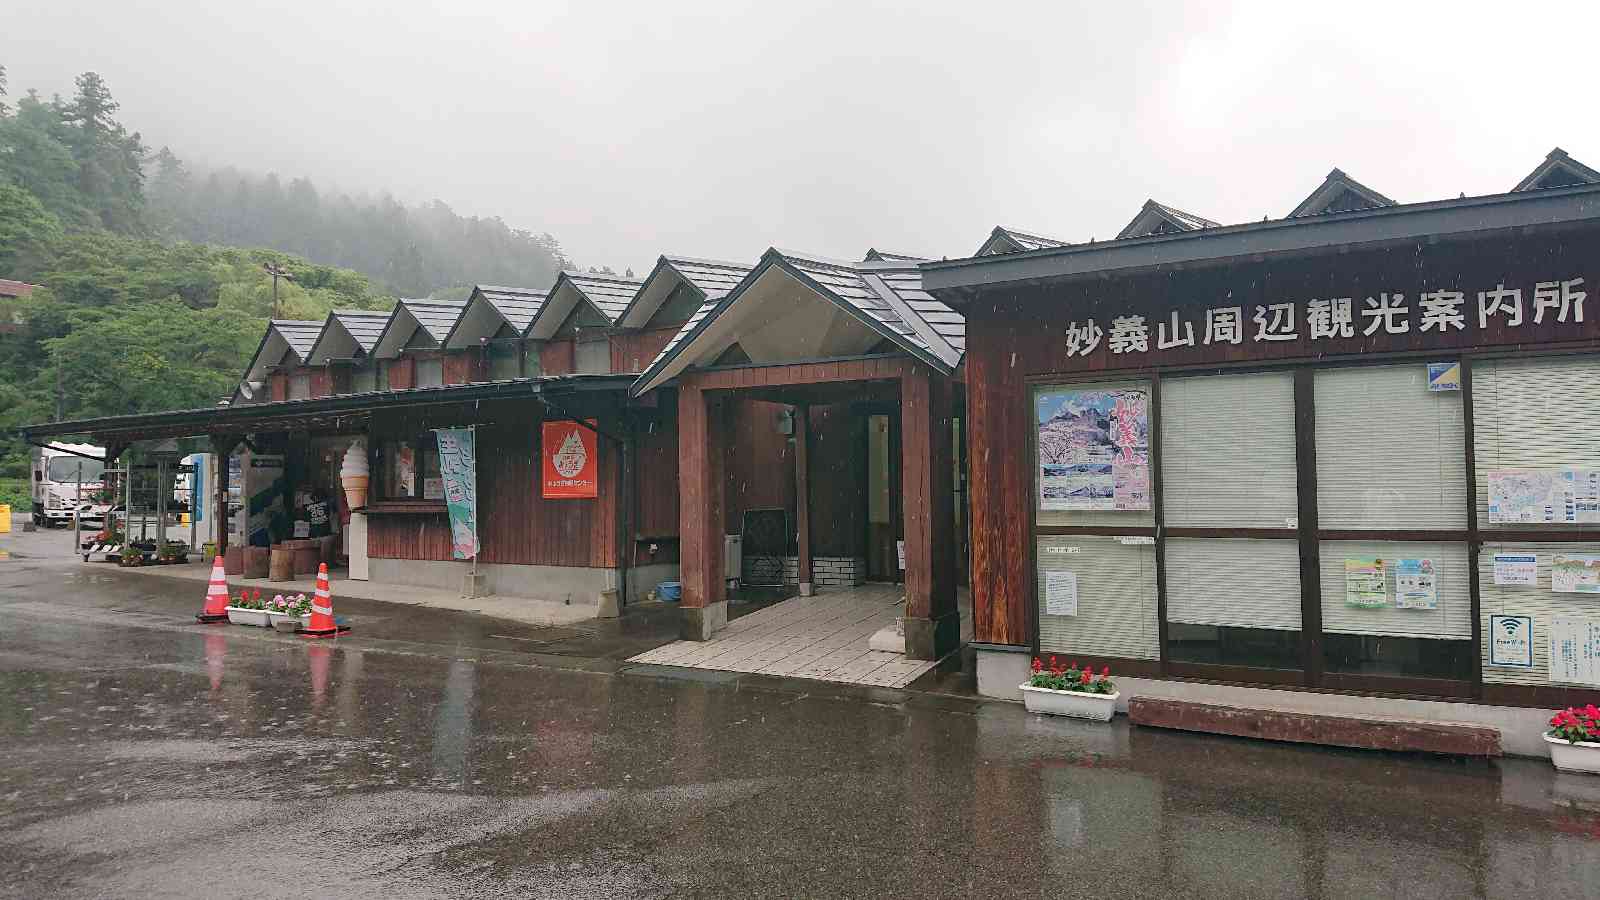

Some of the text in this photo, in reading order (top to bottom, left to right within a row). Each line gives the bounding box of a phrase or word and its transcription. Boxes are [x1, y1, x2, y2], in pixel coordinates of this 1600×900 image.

[1066, 278, 1587, 357] 妙義山周辺観光案内所
